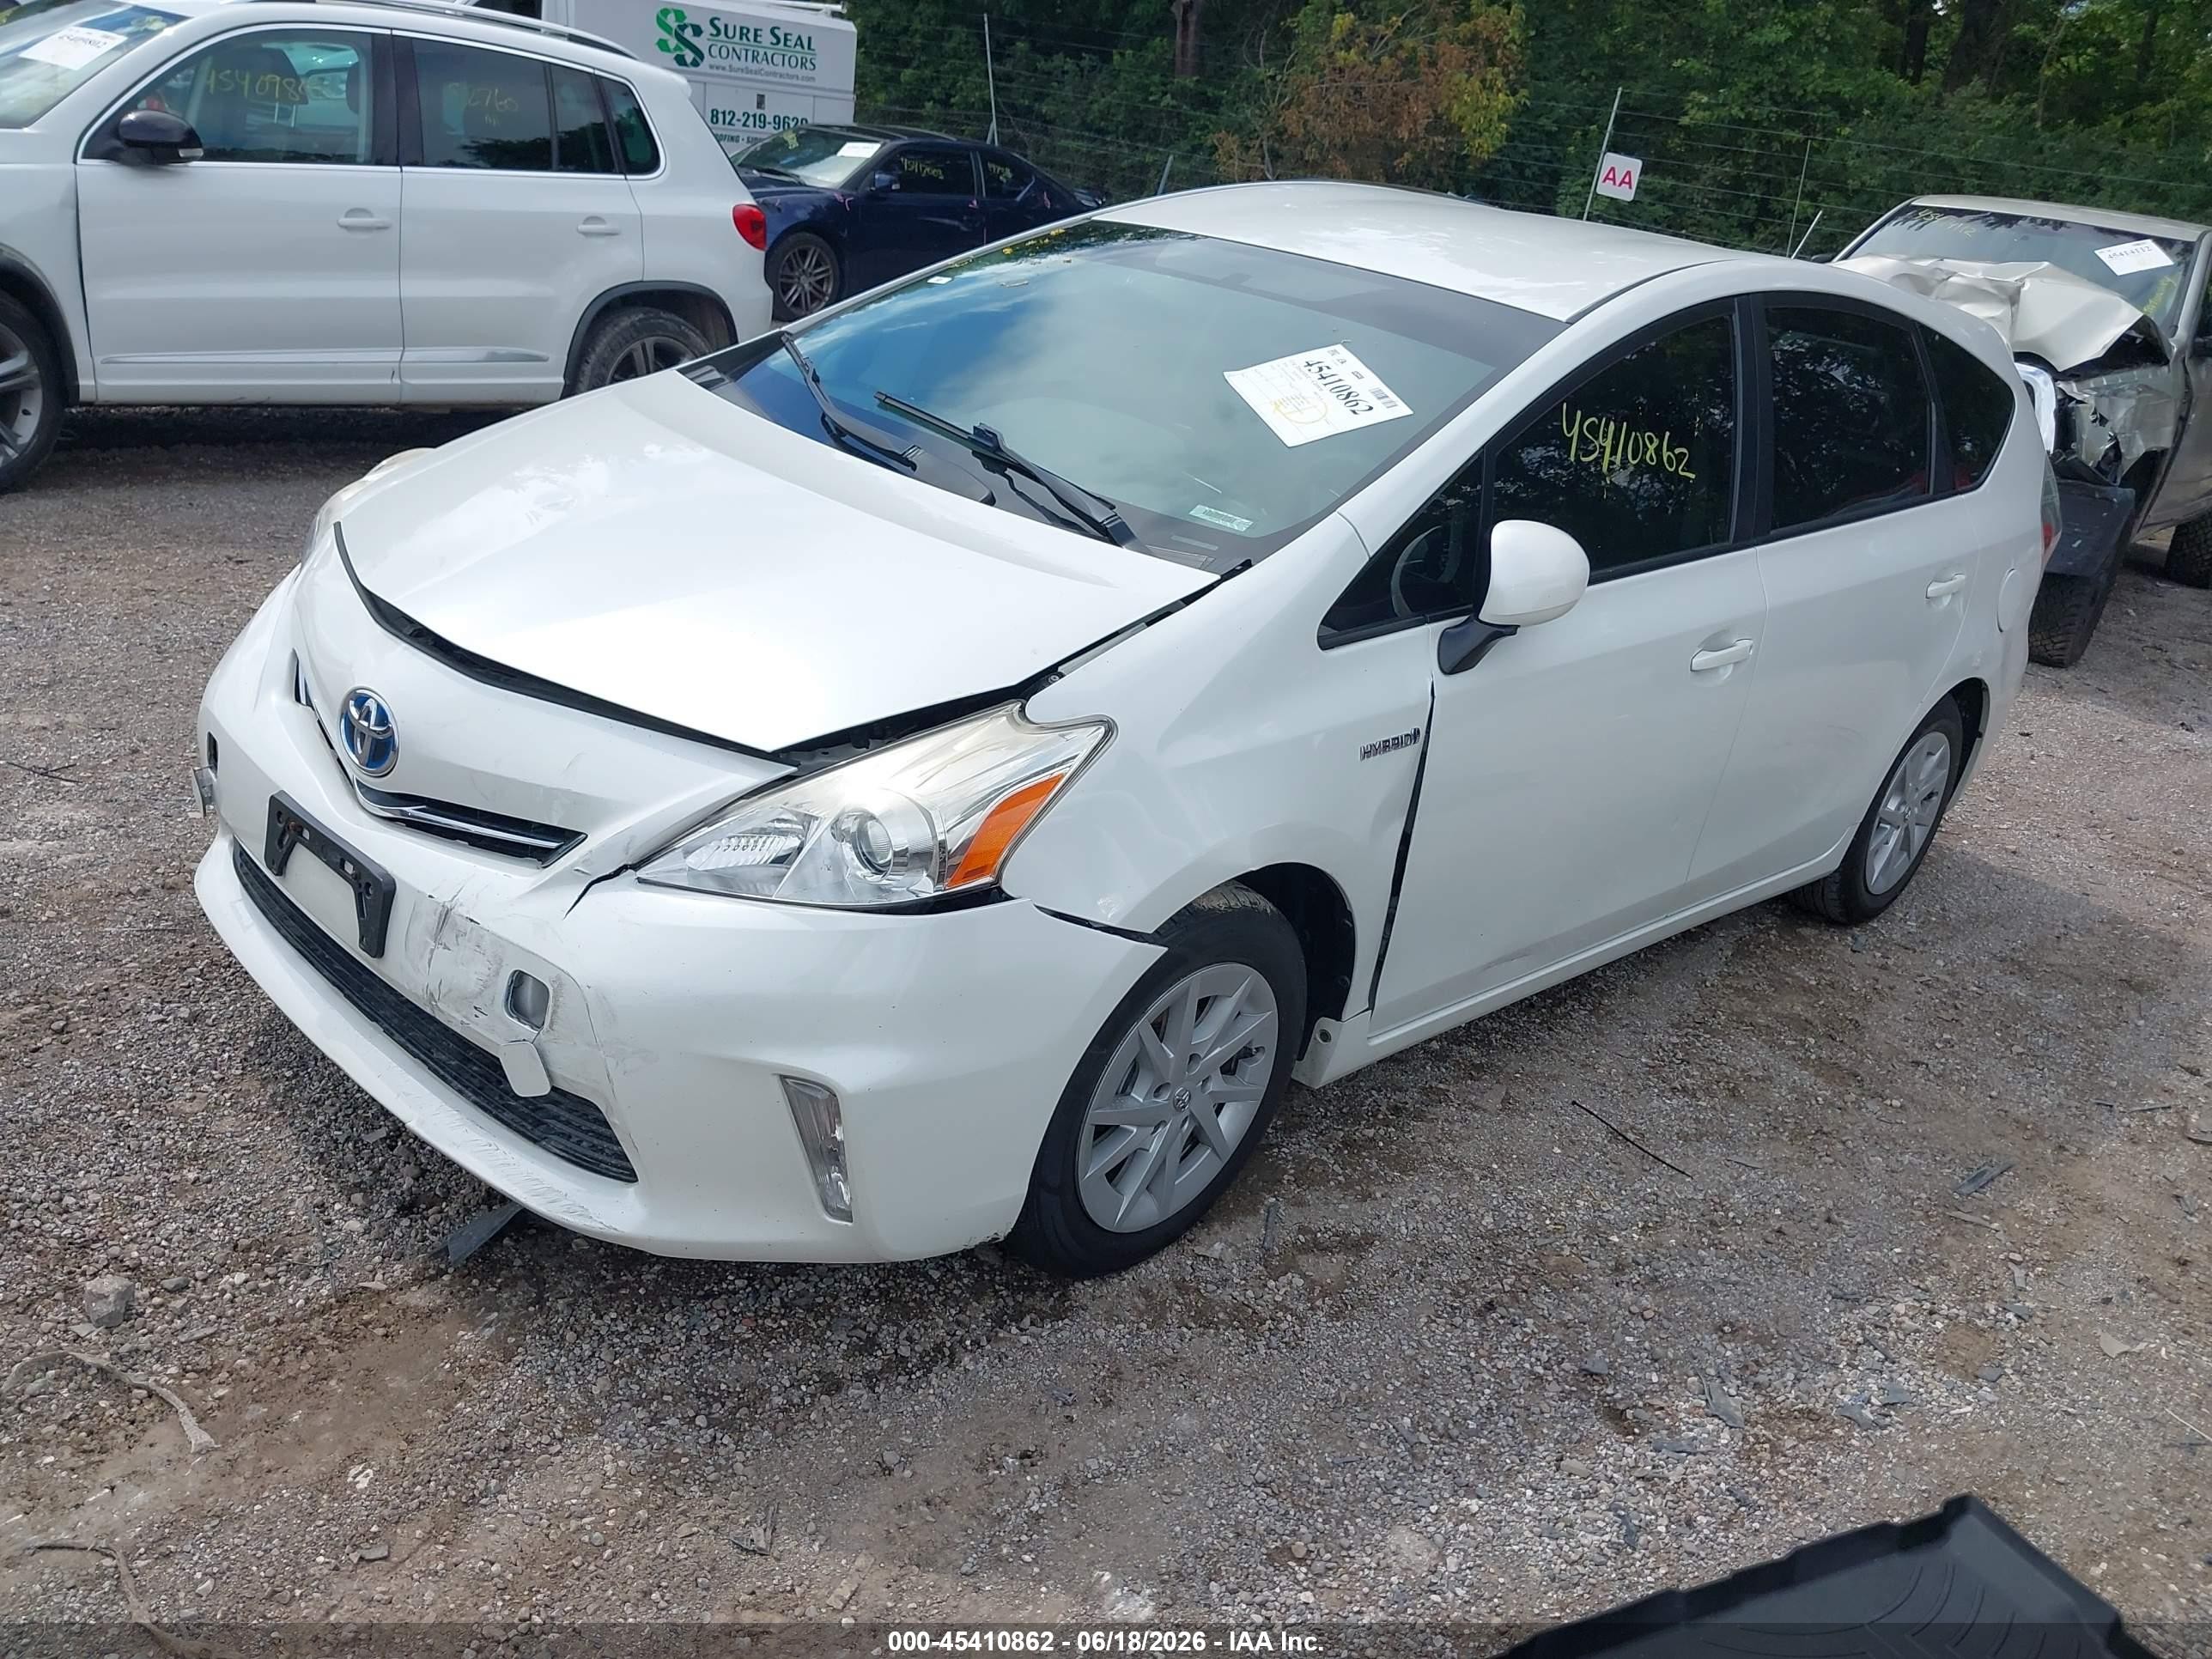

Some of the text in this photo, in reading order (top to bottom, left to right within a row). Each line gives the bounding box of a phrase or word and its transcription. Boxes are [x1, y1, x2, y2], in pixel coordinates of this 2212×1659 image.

[708, 43, 817, 71] CONTRACTORS
[1601, 166, 1633, 190] AA
[1304, 360, 1375, 416] 45410862
[1562, 401, 1697, 481] 45410862
[1359, 731, 1413, 762] HYBRID
